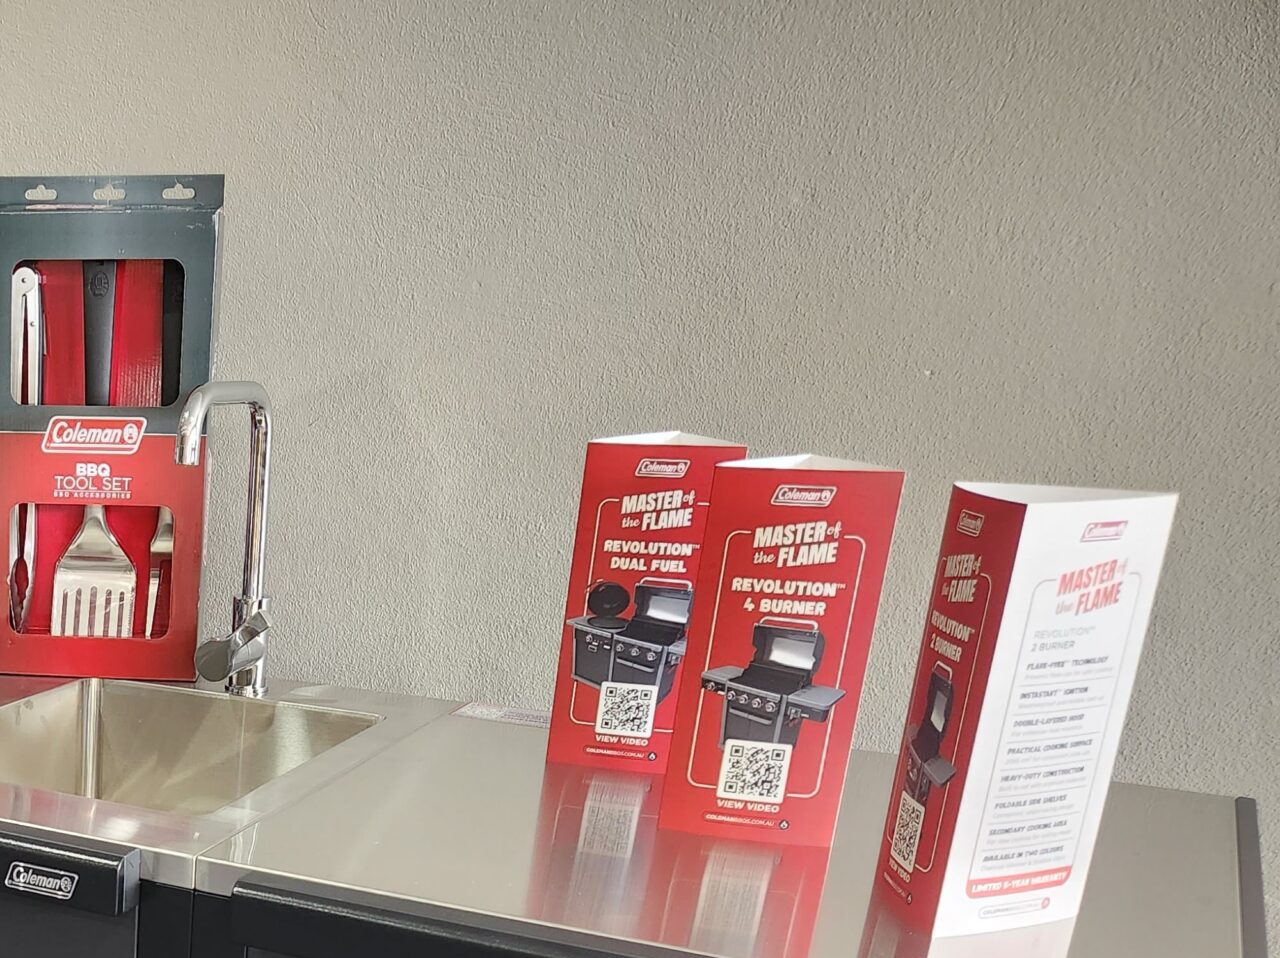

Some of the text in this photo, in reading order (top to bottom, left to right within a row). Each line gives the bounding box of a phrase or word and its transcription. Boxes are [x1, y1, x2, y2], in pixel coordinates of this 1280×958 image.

[52, 421, 122, 443] Coleman
[76, 463, 111, 477] BBQ
[641, 461, 677, 473] Coleman
[54, 476, 132, 491] TOOL SET
[778, 487, 821, 501] Coleman
[621, 489, 696, 514] MASTER of
[622, 508, 694, 531] the FLAME
[753, 521, 842, 548] MASTER of
[610, 557, 687, 573] DUAL FUEL
[753, 542, 839, 568] the FLAME
[944, 554, 975, 578] MASTER
[1056, 559, 1118, 597] MASTER
[948, 579, 978, 602] FLAME
[1075, 581, 1124, 616] FLAME
[743, 597, 827, 616] 4 BURNER
[930, 633, 963, 663] 2 BURNER
[1031, 640, 1076, 652] 2 BURNER
[595, 734, 649, 746] VIEW VIDEO
[716, 799, 780, 813] VIEW VIDEO
[12, 866, 61, 890] Coleman
